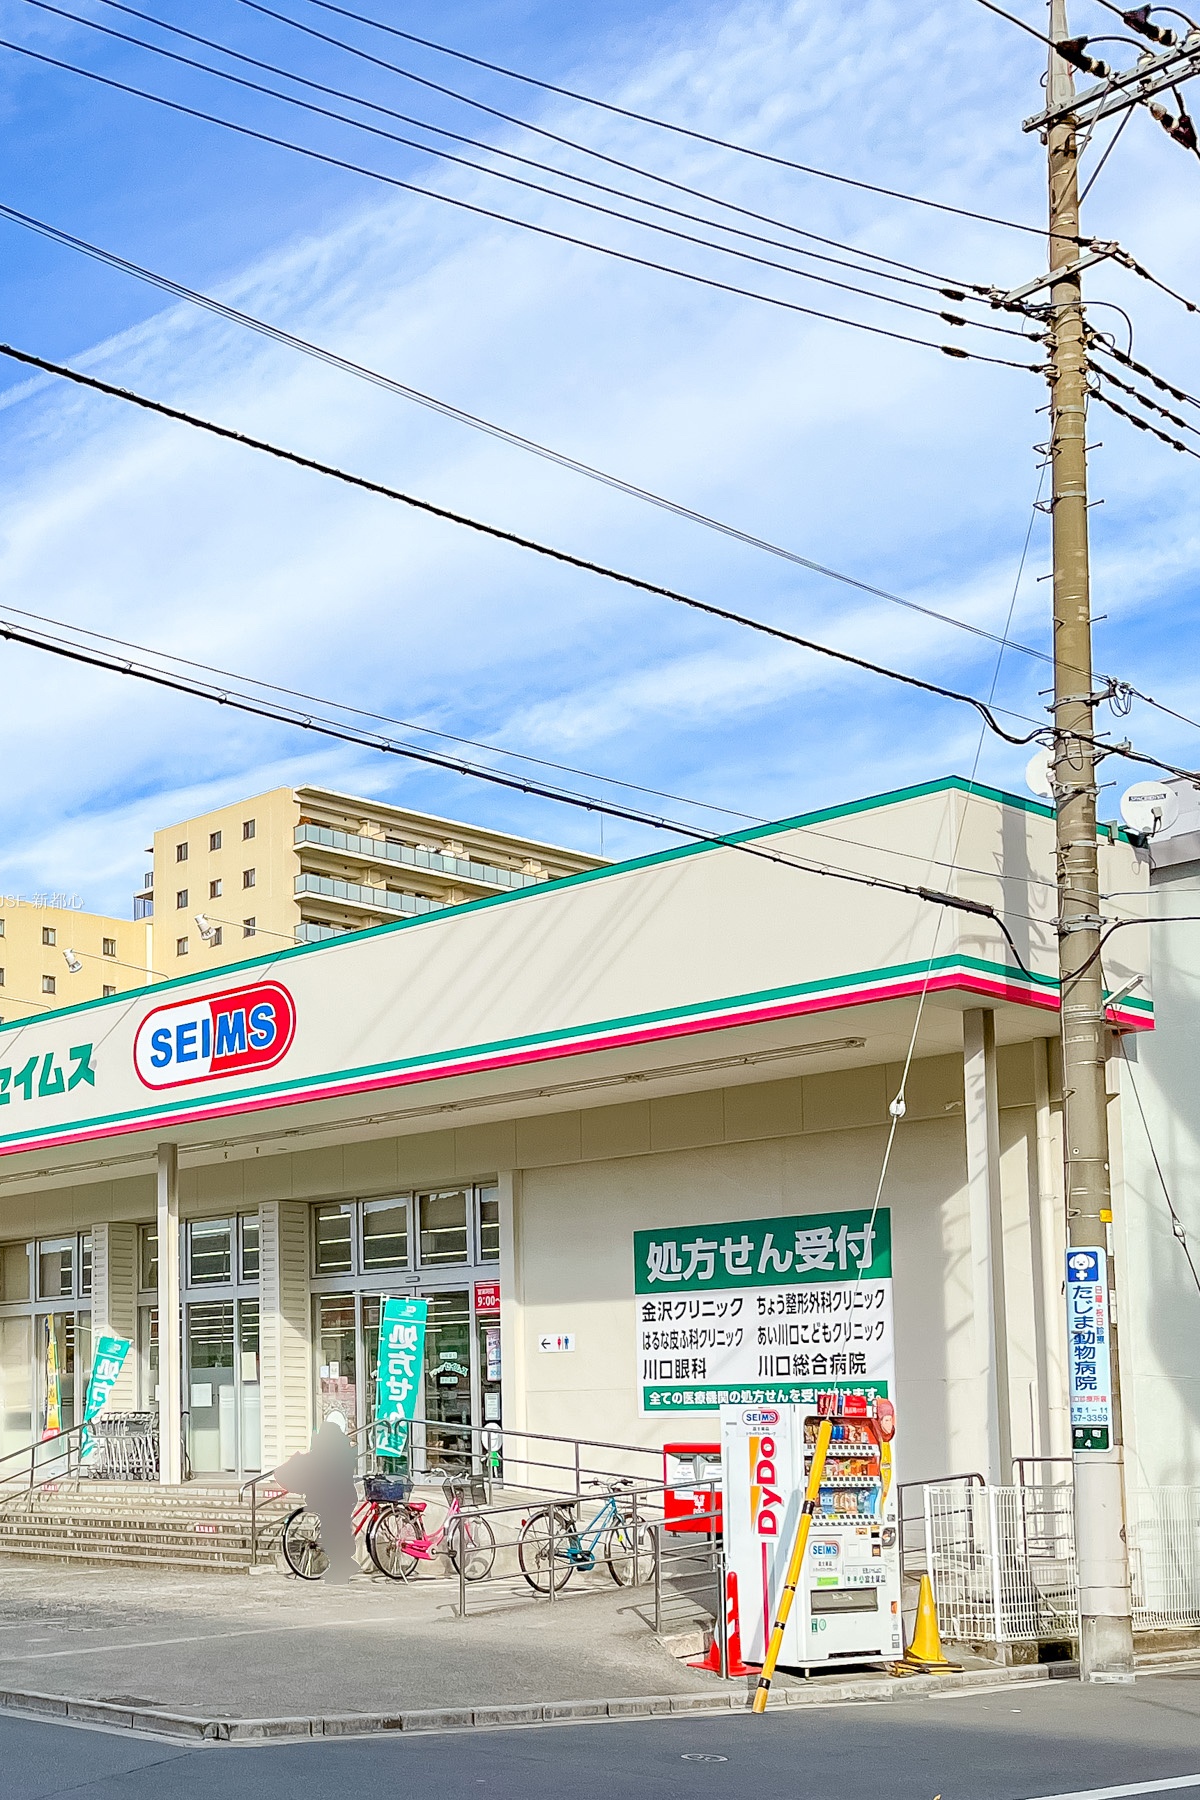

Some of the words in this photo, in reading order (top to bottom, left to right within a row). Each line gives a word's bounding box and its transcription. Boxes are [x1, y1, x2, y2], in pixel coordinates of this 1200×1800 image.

[150, 1004, 276, 1068] SEIMS
[646, 1223, 876, 1283] 処方せん受付
[641, 1298, 744, 1323] 金沢クリニック
[756, 1289, 885, 1316] ちょう整形外科クリニック
[642, 1327, 744, 1351] はるな皮ふ科クリニック
[757, 1321, 885, 1346] あい川口こどもクリニック
[1072, 1285, 1098, 1391] たじま動物病院
[643, 1357, 707, 1380] 川口眼科
[758, 1352, 867, 1377] 川口総合病院
[746, 1413, 775, 1422] SEIMS
[1071, 1414, 1108, 1422] 57-3359
[812, 1545, 837, 1555] SEIMS
